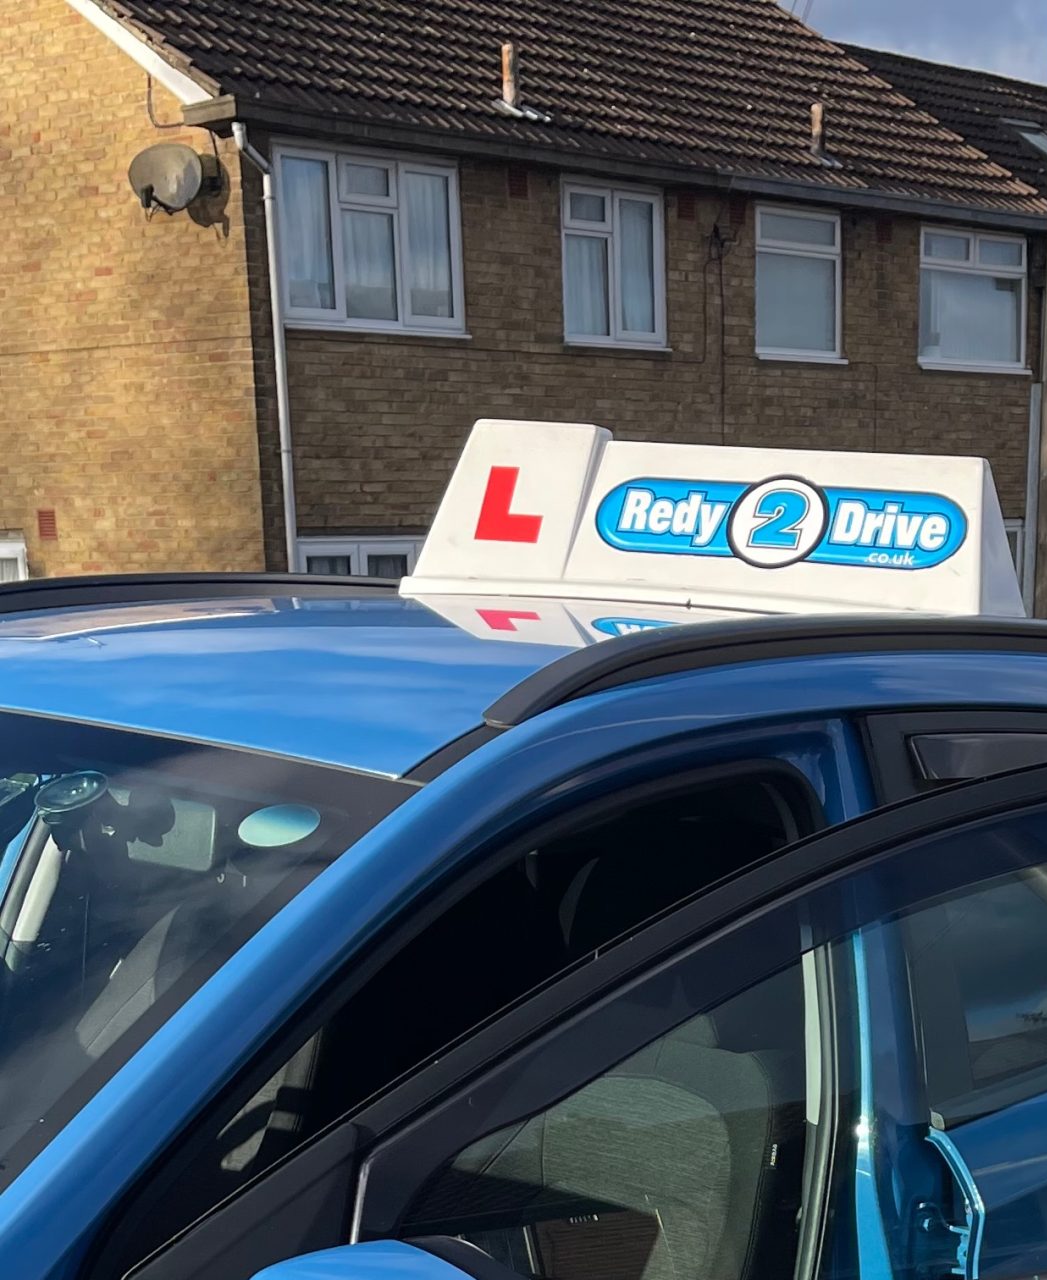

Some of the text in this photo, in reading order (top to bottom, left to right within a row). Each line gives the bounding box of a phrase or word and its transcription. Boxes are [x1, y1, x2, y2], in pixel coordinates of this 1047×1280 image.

[474, 465, 543, 544] L
[617, 488, 951, 550] Redy 2 Drive
